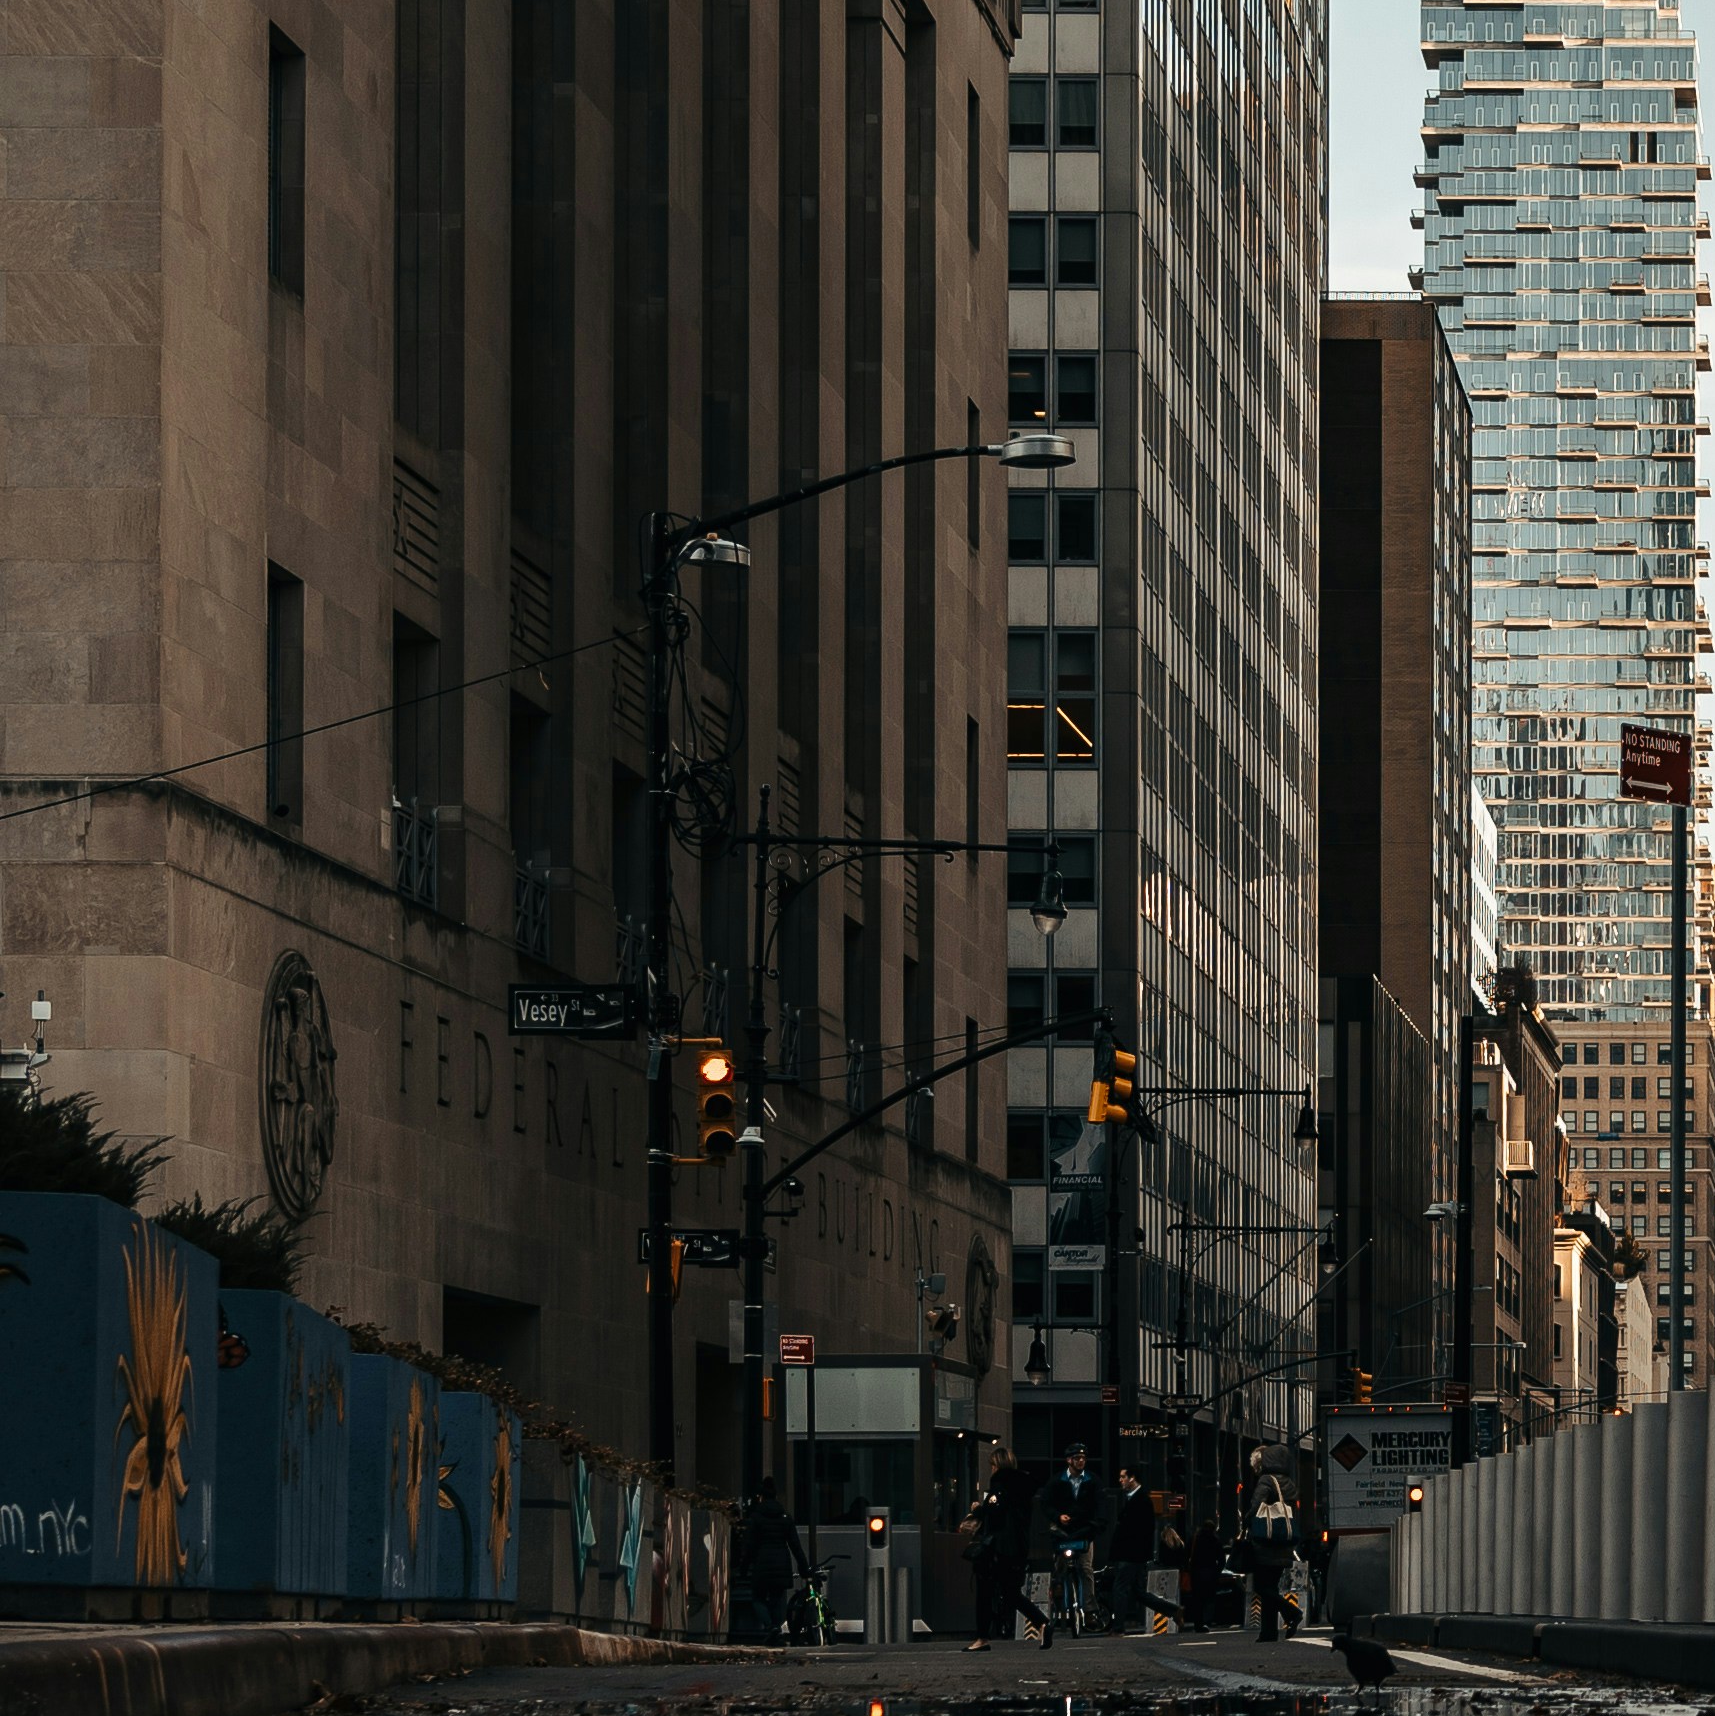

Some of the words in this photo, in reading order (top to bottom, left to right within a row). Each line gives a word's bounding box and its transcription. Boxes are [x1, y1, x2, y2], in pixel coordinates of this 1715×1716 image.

[1625, 732, 1638, 746] NO
[1640, 735, 1680, 754] STANDING
[1626, 749, 1661, 767] Anytime
[519, 998, 568, 1027] Vesey
[399, 999, 623, 1168] FEDERAL
[1052, 1175, 1104, 1185] FINANCIAL
[817, 1171, 940, 1275] BUILDING
[1119, 1427, 1147, 1437] Barclay
[1371, 1431, 1451, 1448] MERCURY
[1372, 1449, 1449, 1466] LIGHTING
